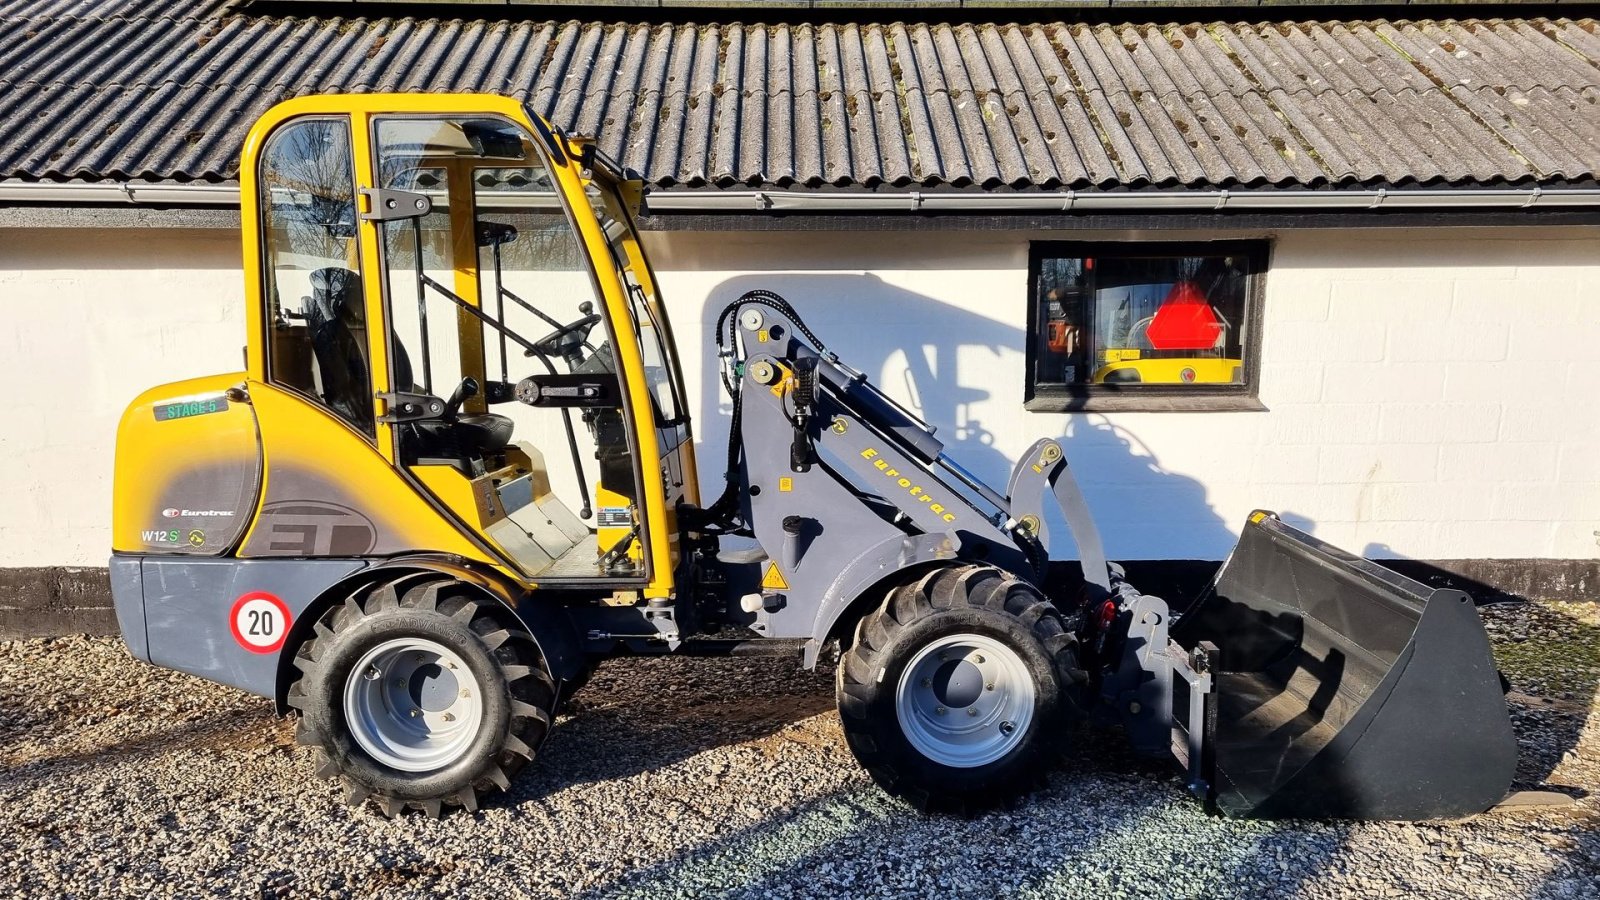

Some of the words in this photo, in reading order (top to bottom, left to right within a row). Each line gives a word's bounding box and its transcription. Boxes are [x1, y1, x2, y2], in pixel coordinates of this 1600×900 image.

[167, 402, 206, 418] STAGE
[208, 400, 217, 412] 5
[860, 447, 957, 523] Eurotrac
[181, 509, 235, 517] Eurotrac
[247, 610, 273, 636] 20
